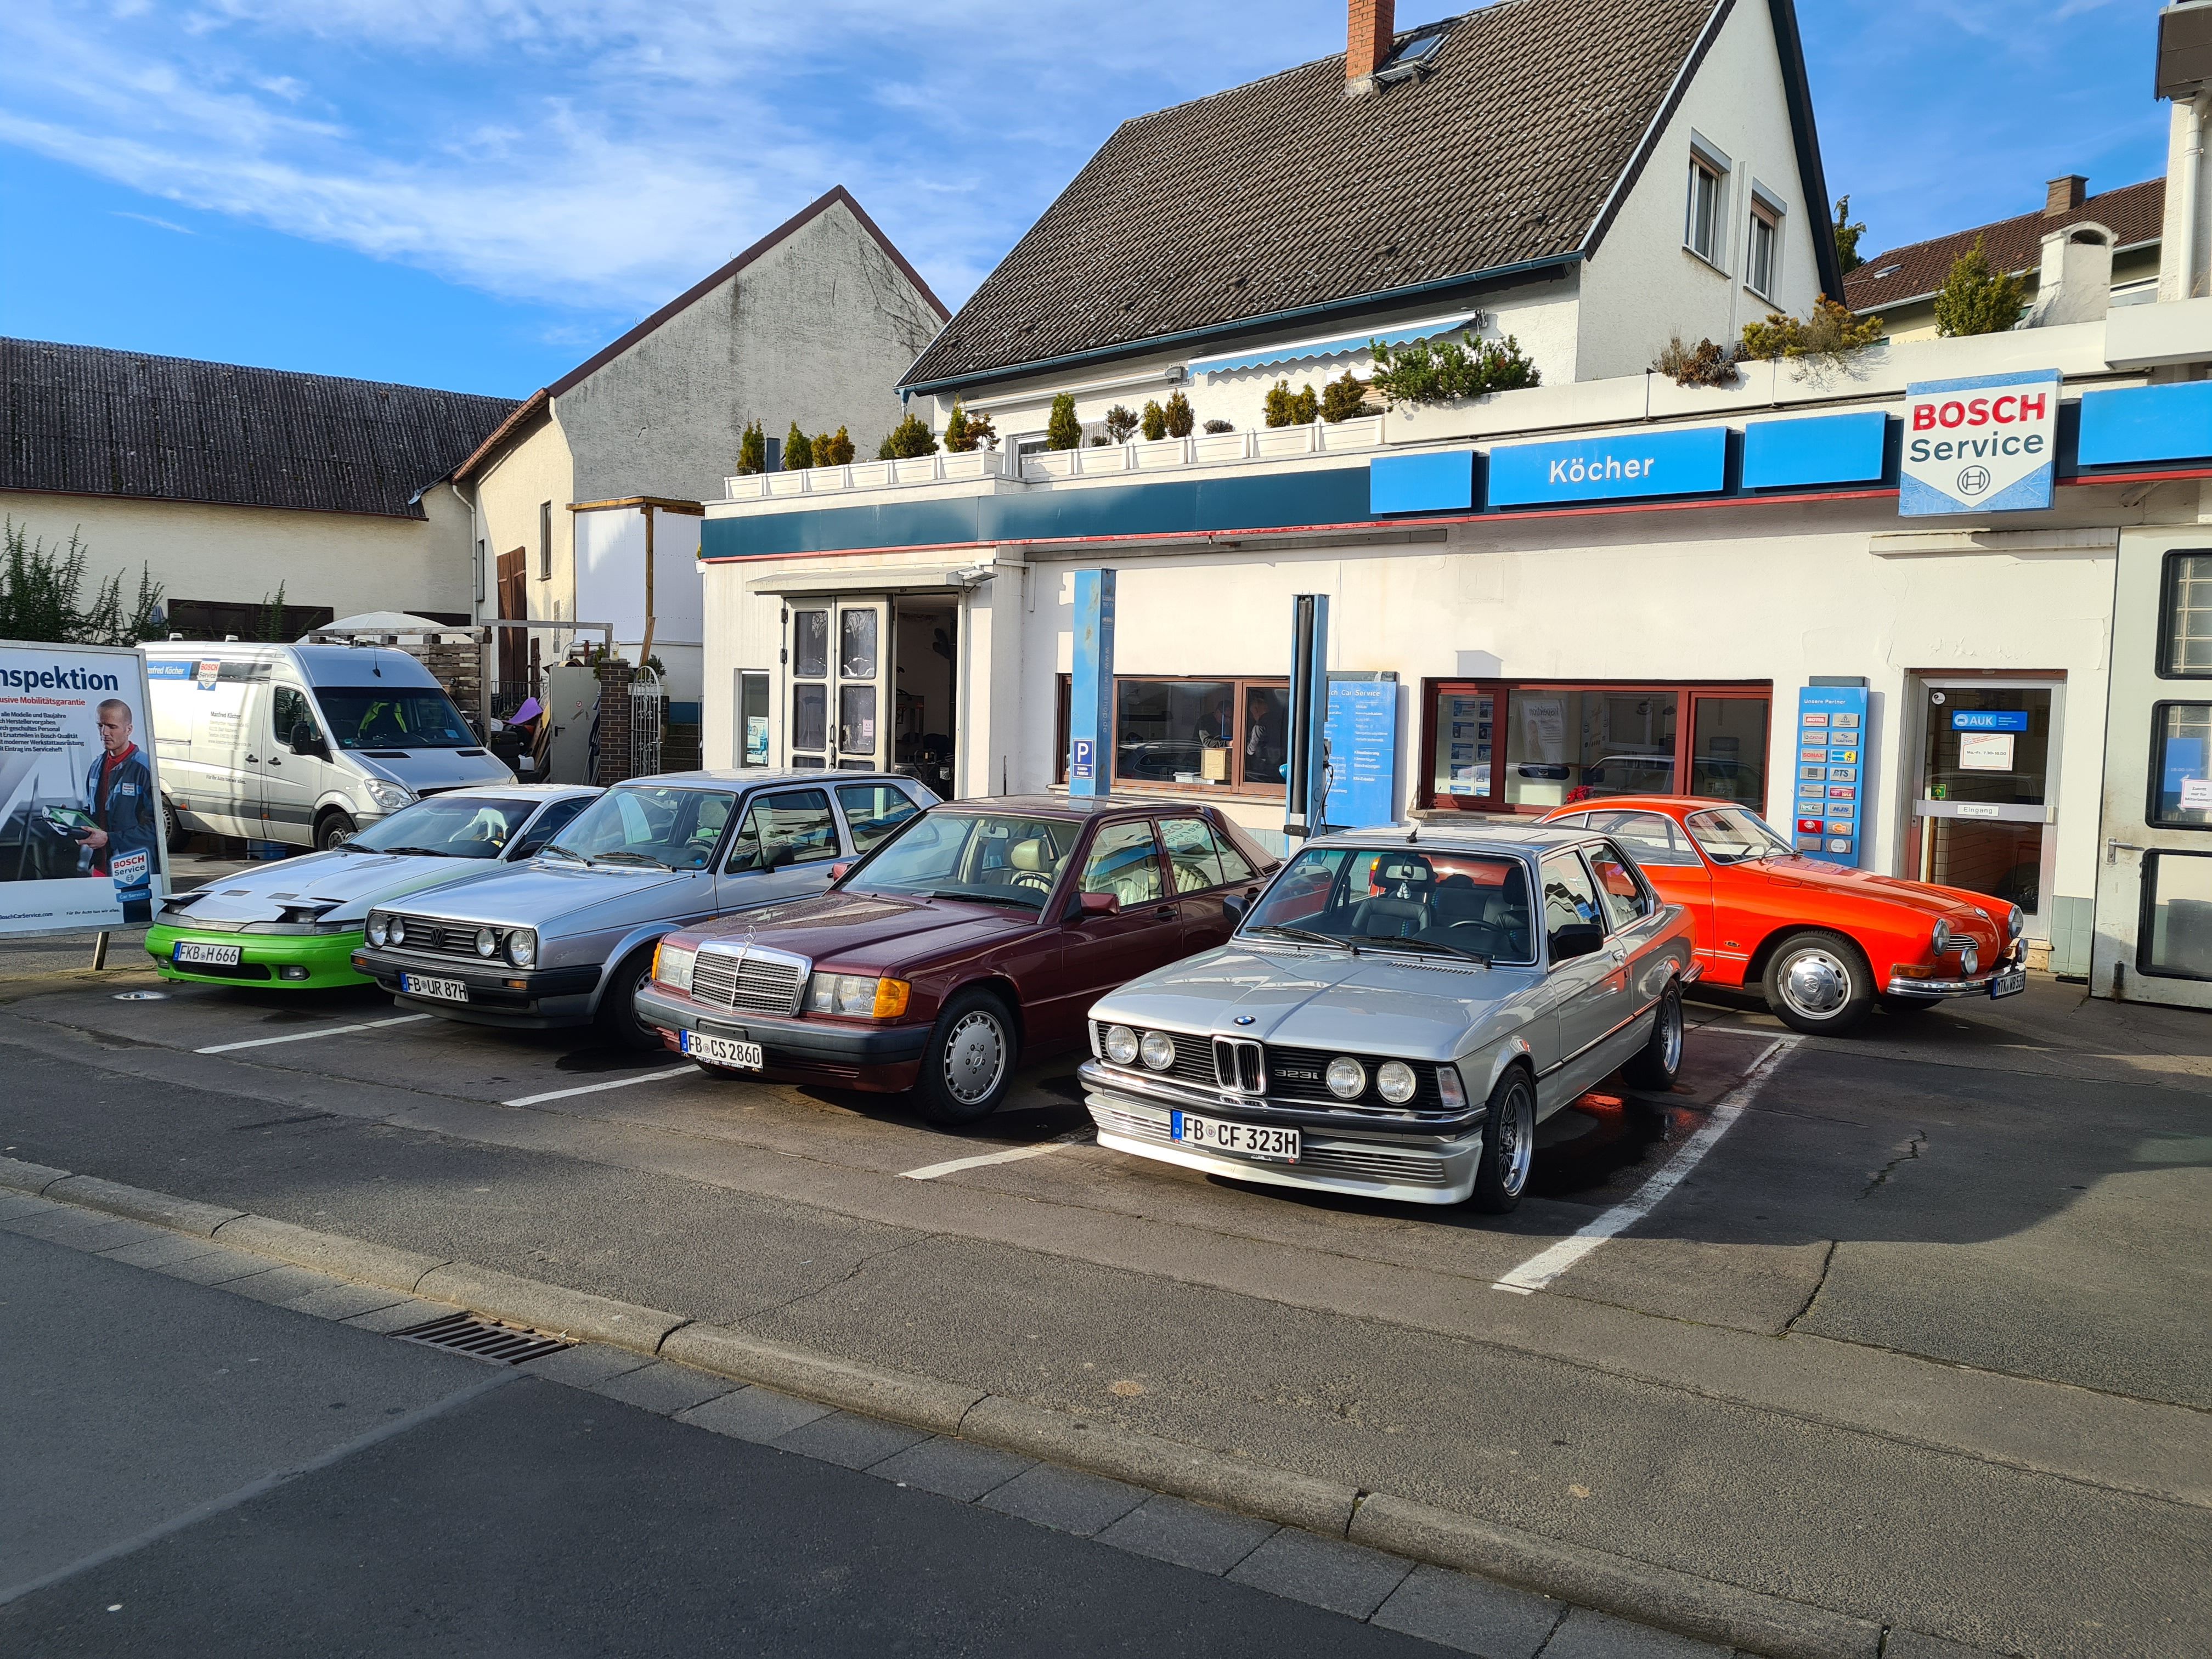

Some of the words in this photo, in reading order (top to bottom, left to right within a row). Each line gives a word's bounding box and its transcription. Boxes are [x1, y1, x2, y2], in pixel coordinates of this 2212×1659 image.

[1913, 393, 2046, 431] BOSCH
[1909, 431, 2044, 462] Service
[1549, 455, 1654, 483] Köcher
[165, 666, 185, 675] Köcher
[20, 696, 86, 706] Mobilitätsgarantie
[1970, 716, 1993, 725] AUK
[1077, 742, 1089, 763] P
[114, 855, 144, 868] BOSCH
[114, 864, 145, 876] Service
[179, 945, 200, 960] FKB
[206, 947, 215, 962] H
[216, 948, 236, 963] 666
[406, 977, 421, 992] FB
[427, 979, 443, 996] UR
[444, 982, 468, 1000] 87H
[1997, 978, 2007, 994] MTK
[688, 1034, 702, 1053] FB
[711, 1039, 726, 1059] CS
[729, 1043, 760, 1065] 2860
[1274, 1069, 1319, 1080] 323i
[1183, 1117, 1204, 1141] FB
[1218, 1124, 1241, 1147] CF
[1246, 1128, 1297, 1155] 323H
